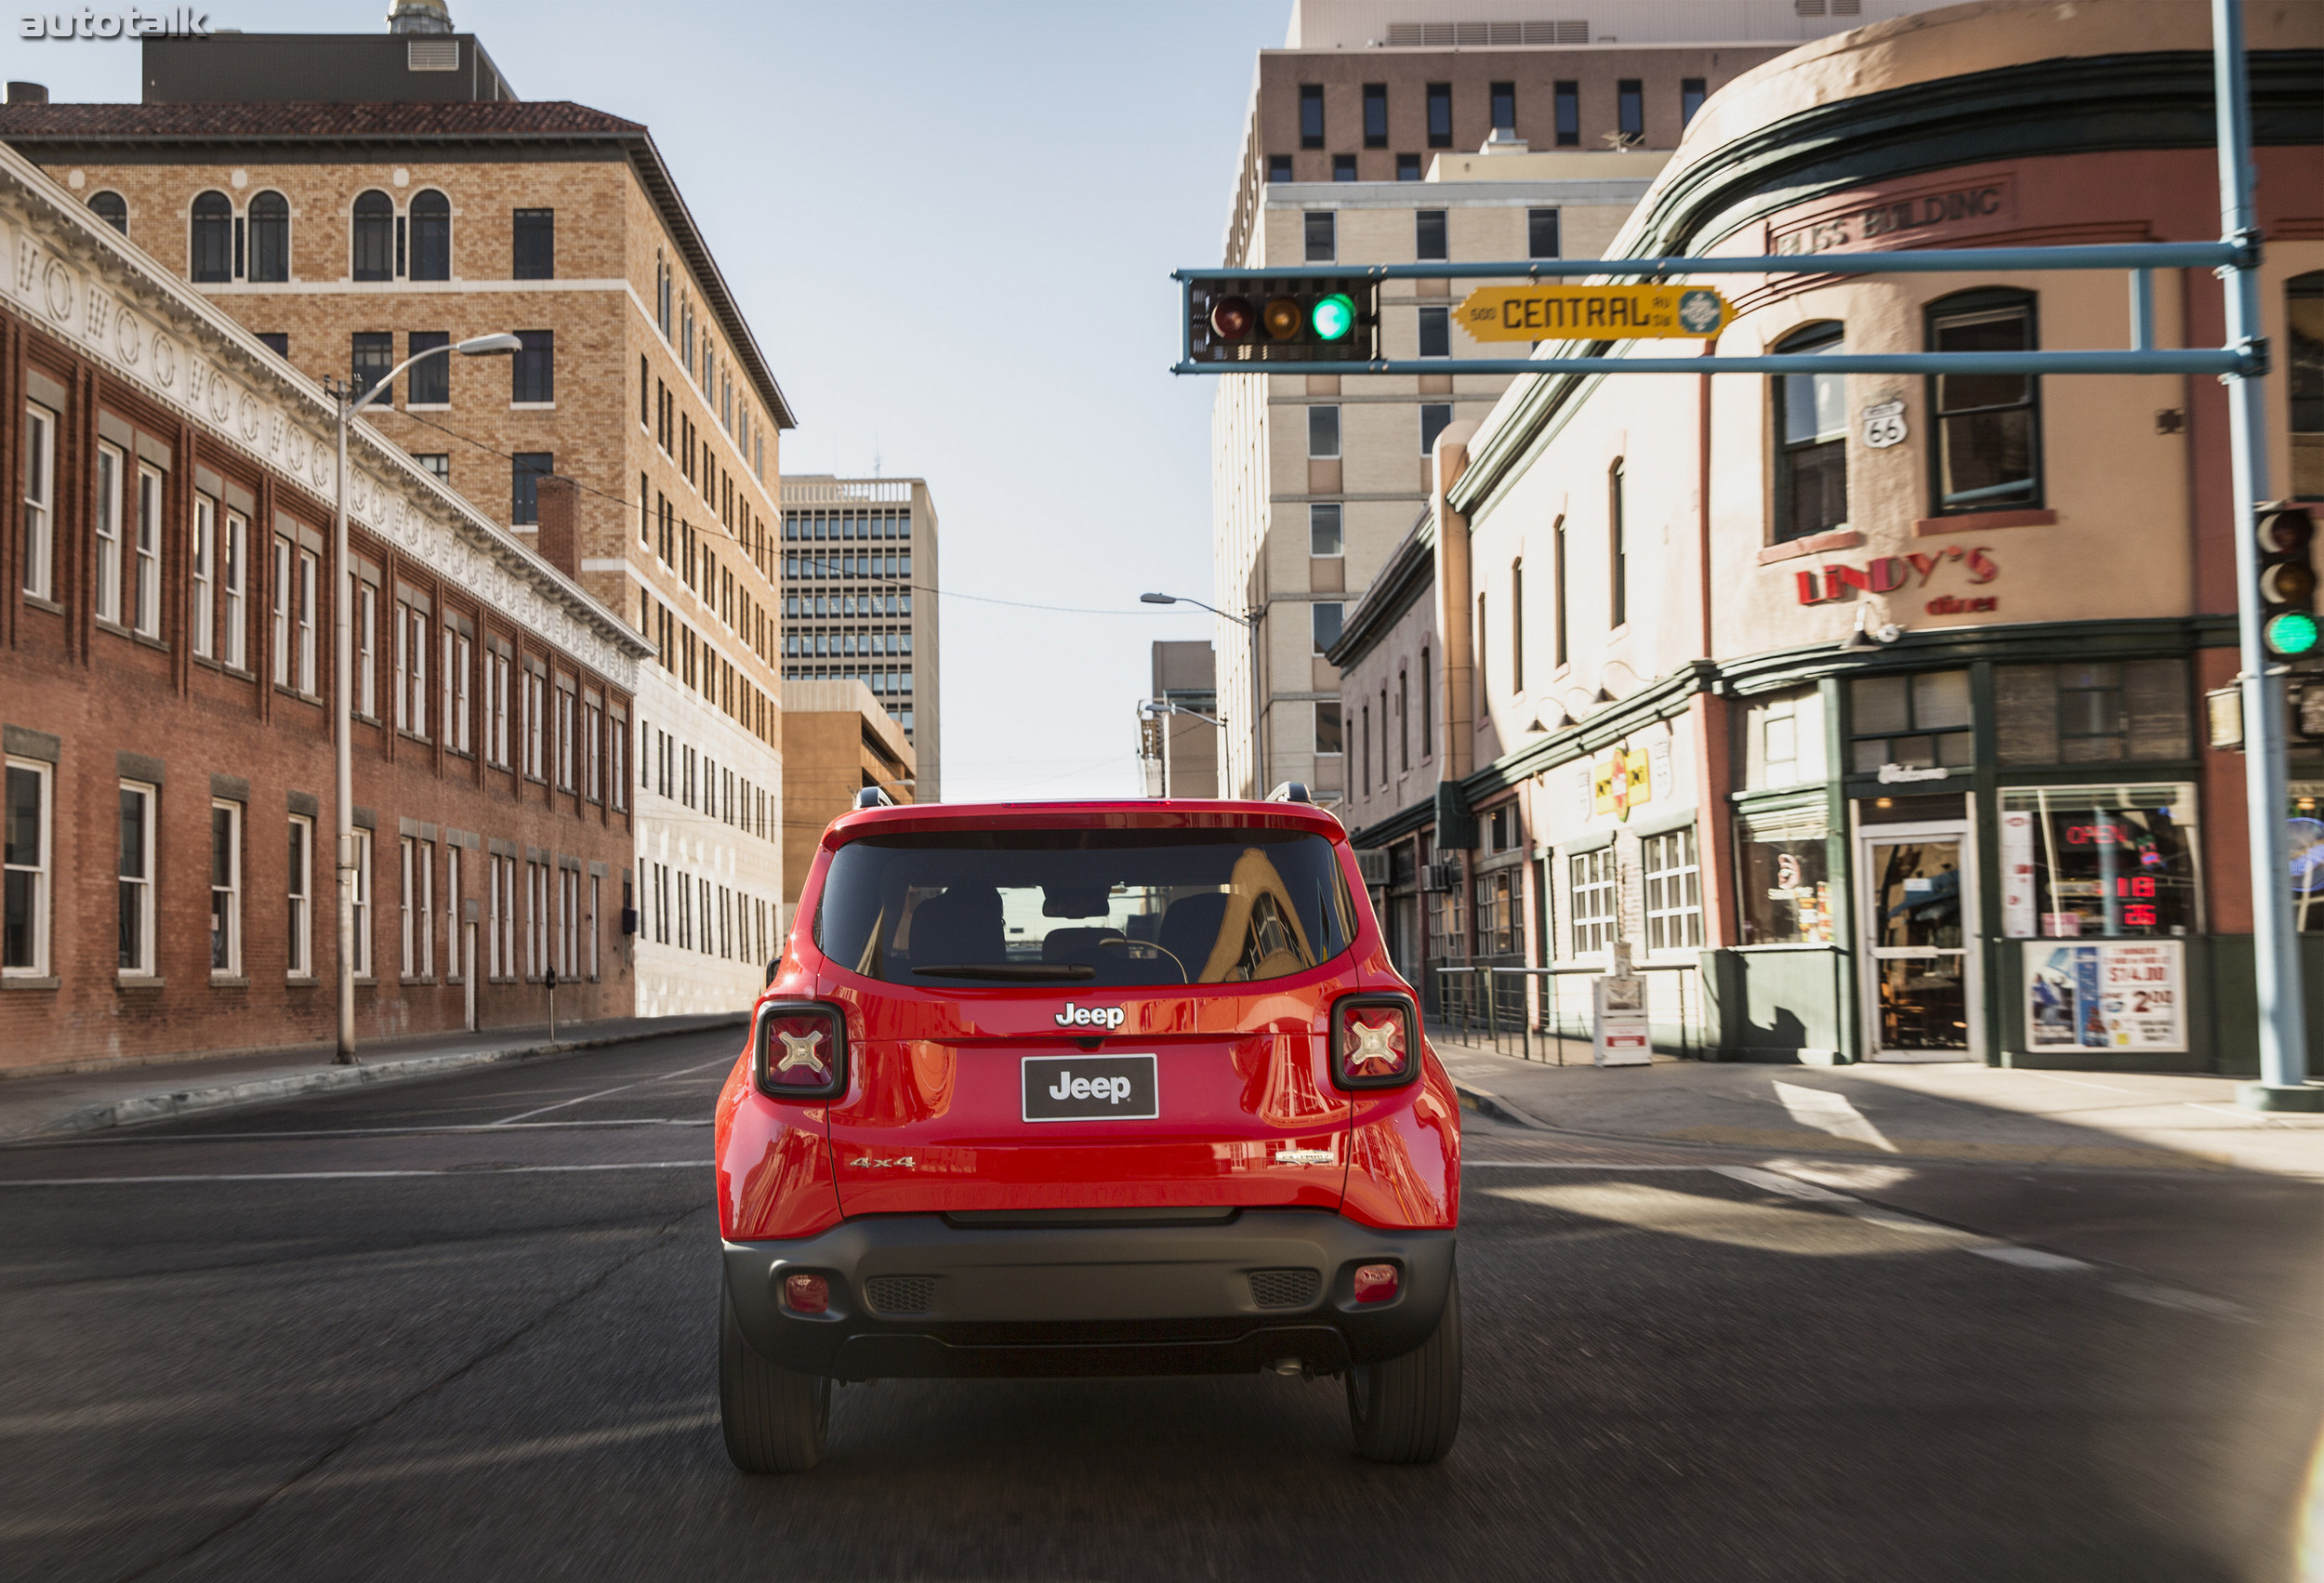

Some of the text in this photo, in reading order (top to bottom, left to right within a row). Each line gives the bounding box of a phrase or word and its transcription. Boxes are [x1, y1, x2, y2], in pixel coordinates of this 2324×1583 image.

[1862, 189, 2000, 238] BUILDING
[1503, 297, 1650, 328] CENTRAL
[1869, 418, 1898, 442] 66
[1055, 1002, 1125, 1030] Jeep
[1049, 1071, 1131, 1104] Jeep
[850, 1156, 916, 1168] 4x4
